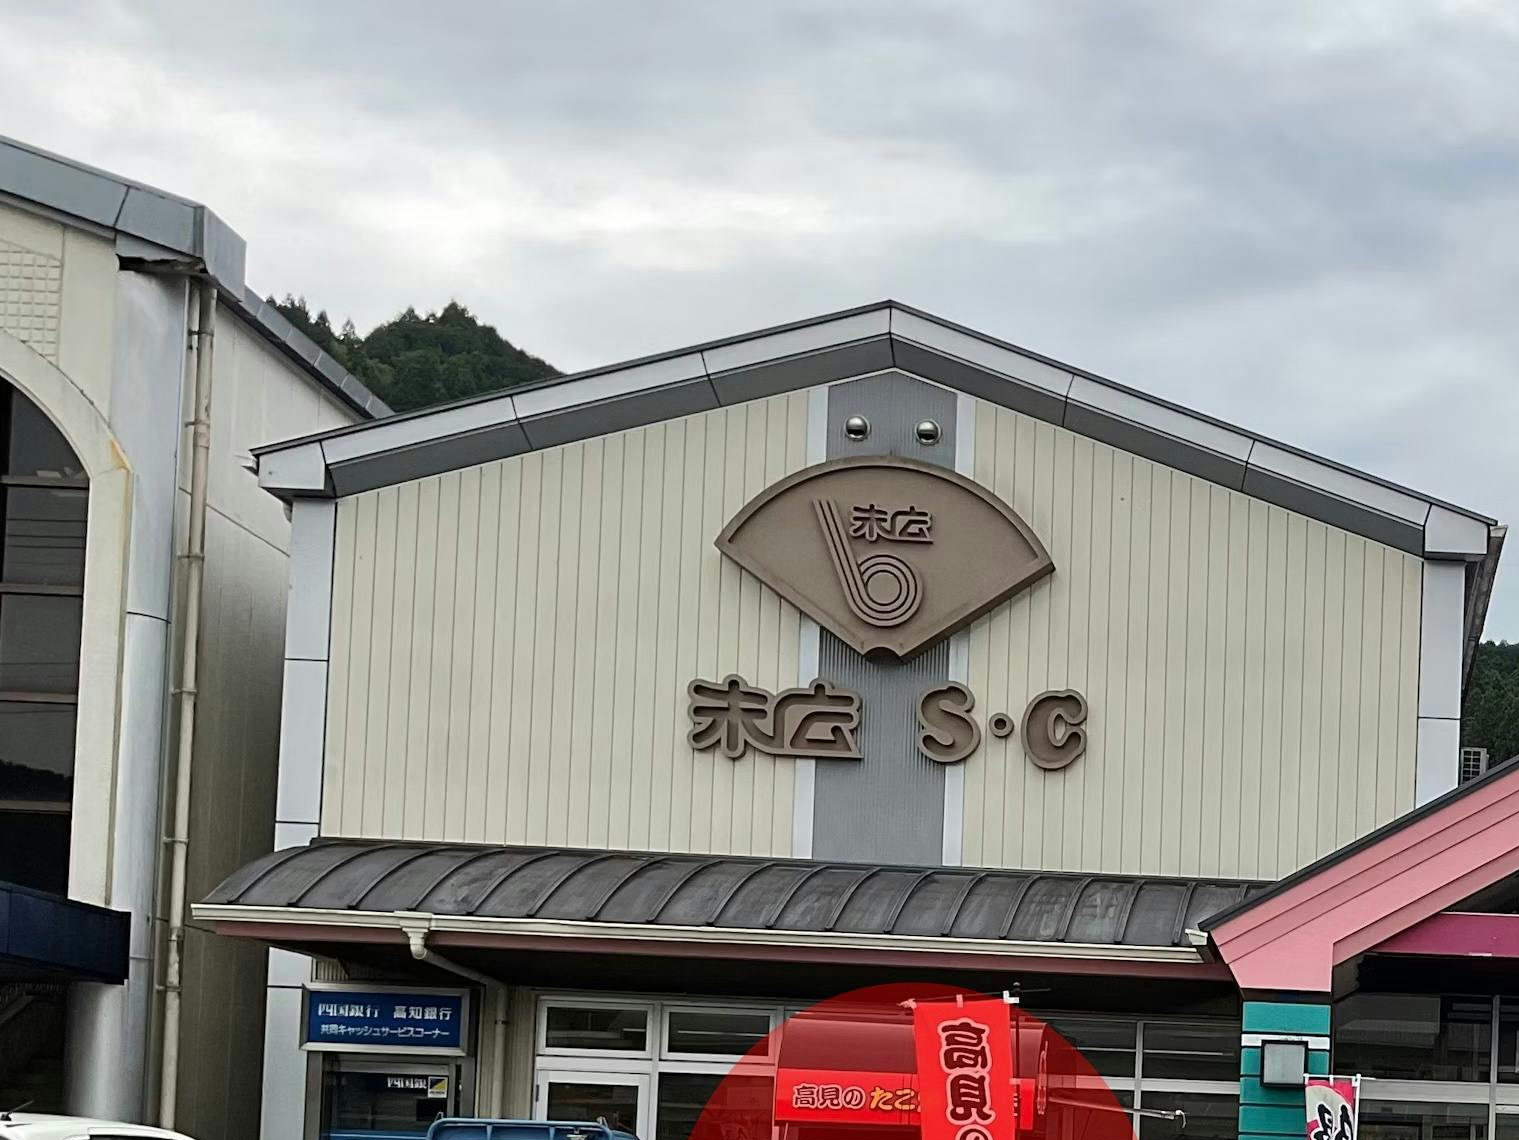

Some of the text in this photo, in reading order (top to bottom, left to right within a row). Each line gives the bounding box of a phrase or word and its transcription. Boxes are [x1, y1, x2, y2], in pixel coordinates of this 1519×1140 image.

[848, 503, 934, 544] 末広
[687, 673, 864, 760] 末広
[318, 1002, 453, 1021] 四国銀行 高知銀行
[320, 1023, 450, 1039] 共同キャッシュサービスコーナー
[794, 1083, 920, 1111] 高見のたこ
